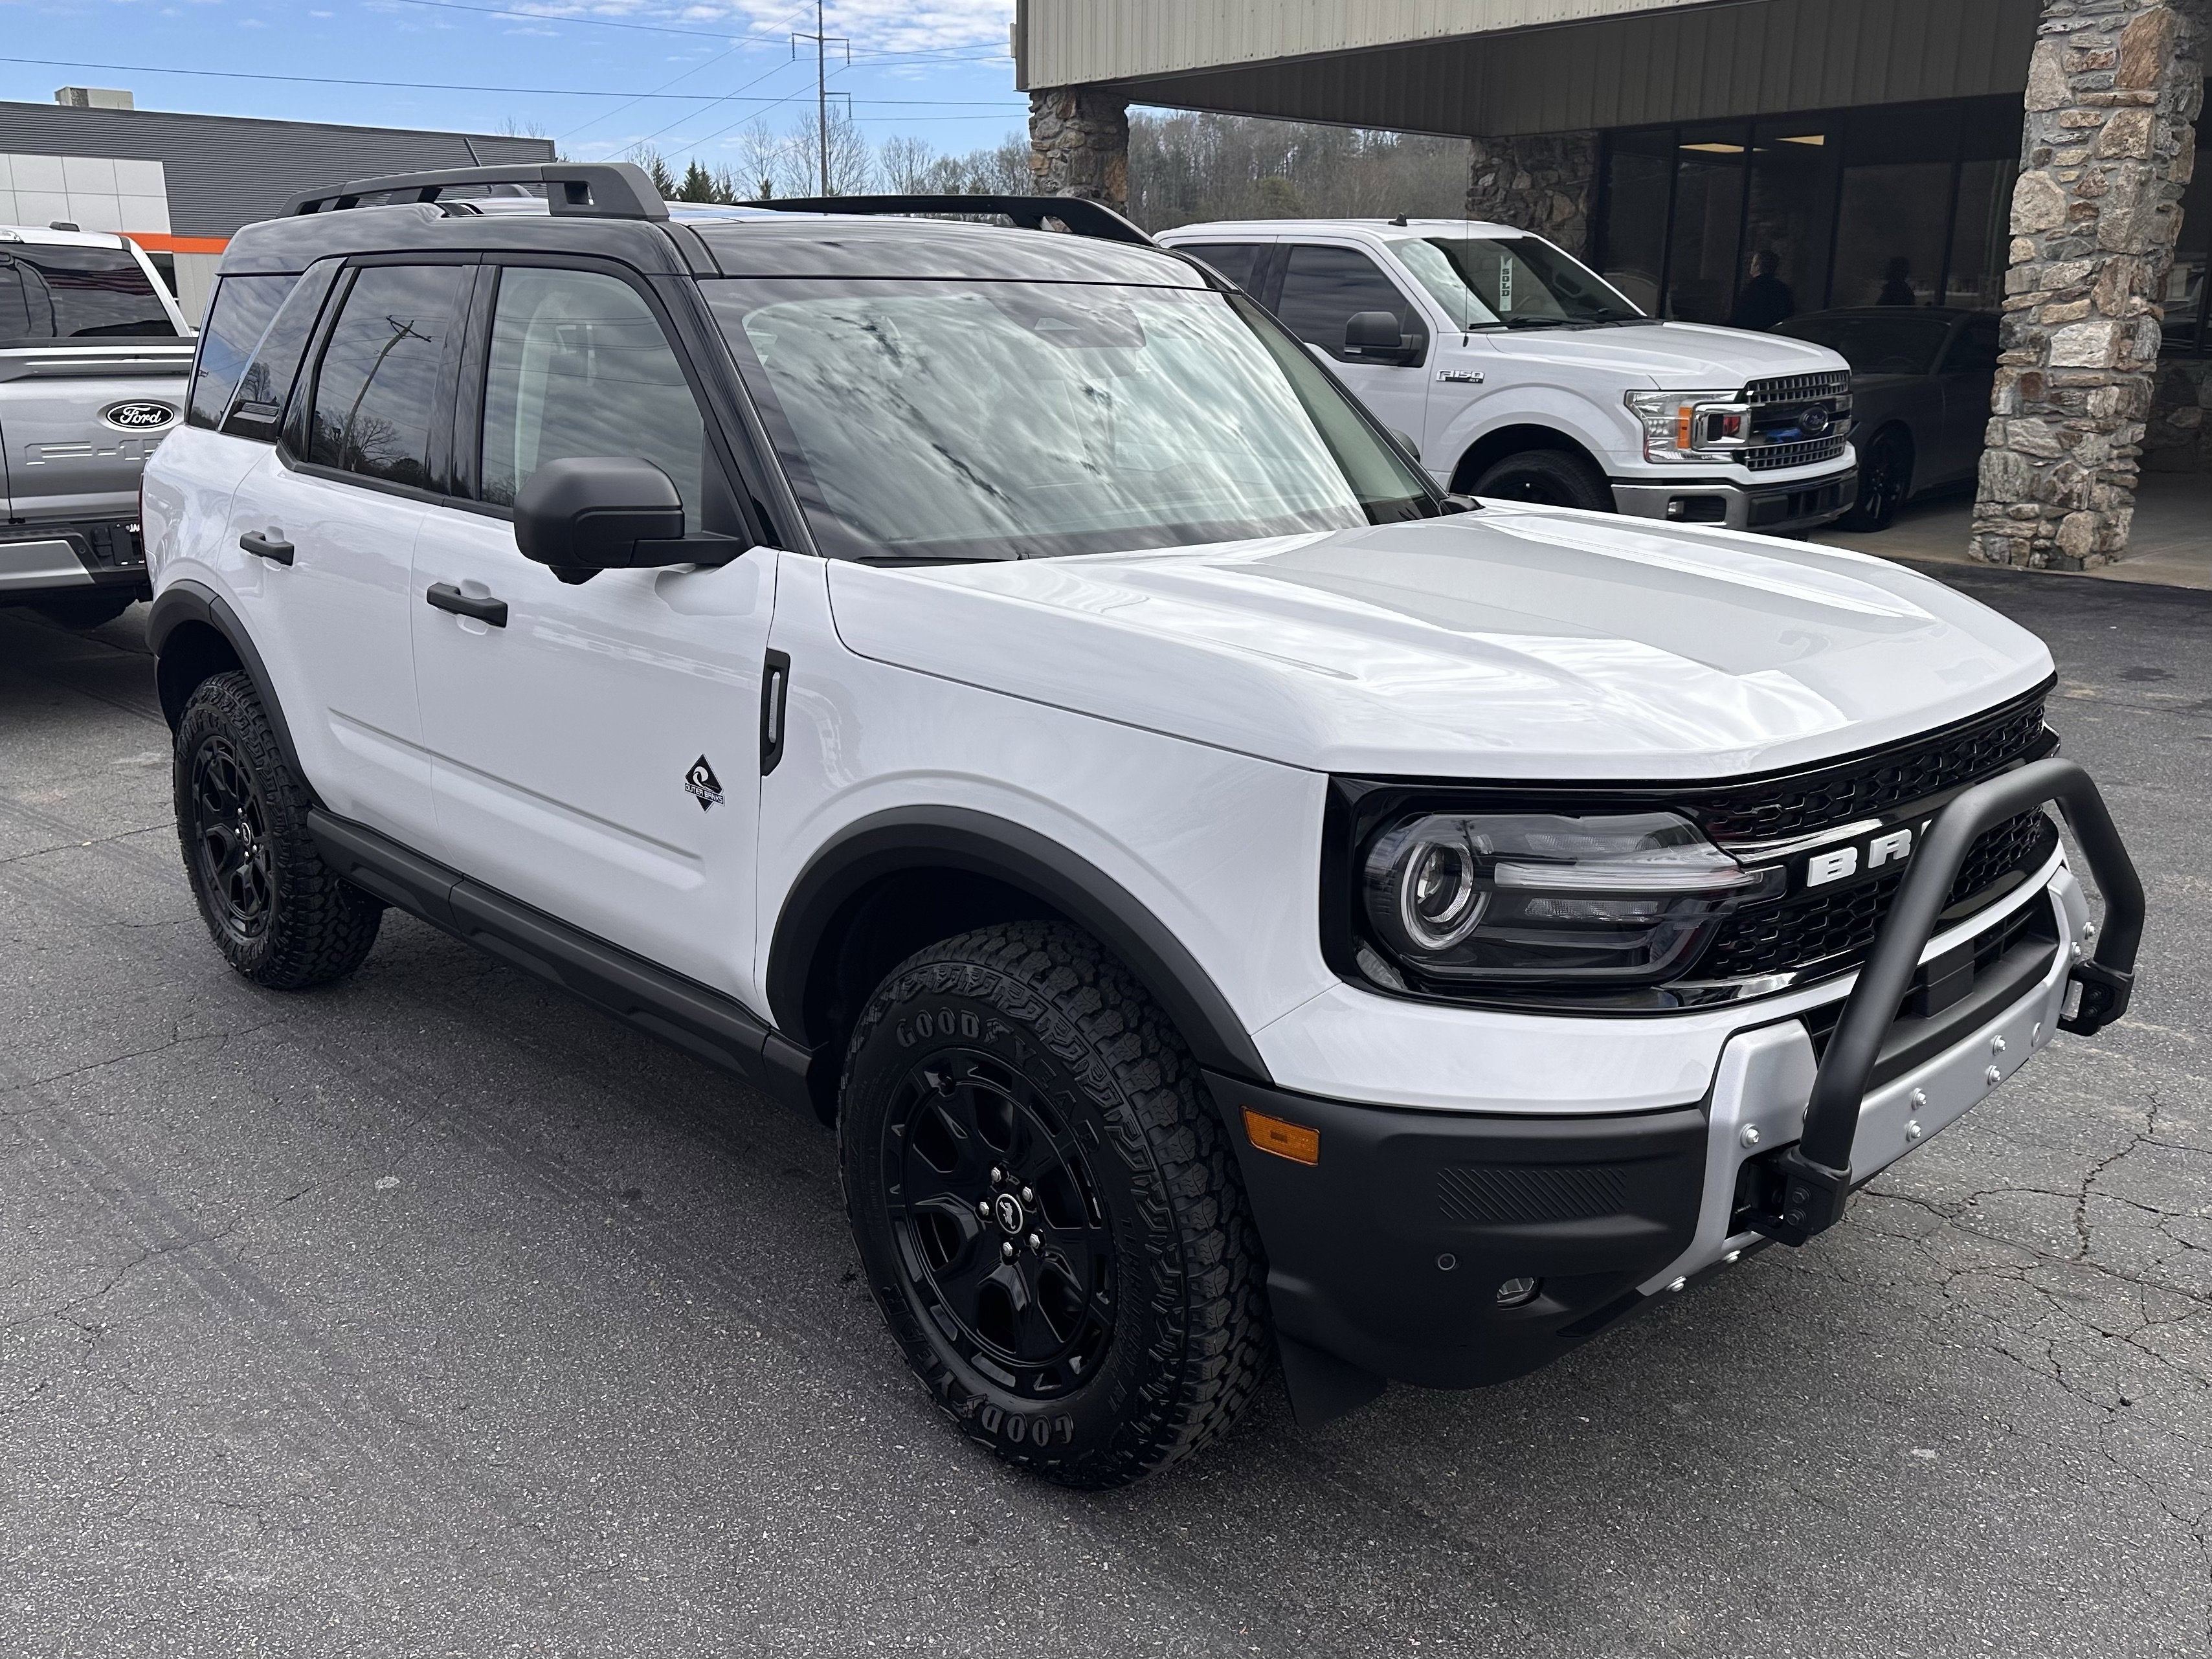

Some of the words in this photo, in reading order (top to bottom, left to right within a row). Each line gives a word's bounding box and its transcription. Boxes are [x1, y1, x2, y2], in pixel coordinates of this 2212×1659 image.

[1502, 268, 1510, 296] SOLD
[120, 406, 162, 424] Ford
[686, 784, 704, 796] OUTER
[704, 790, 723, 803] BANKS
[1807, 819, 1932, 887] BR
